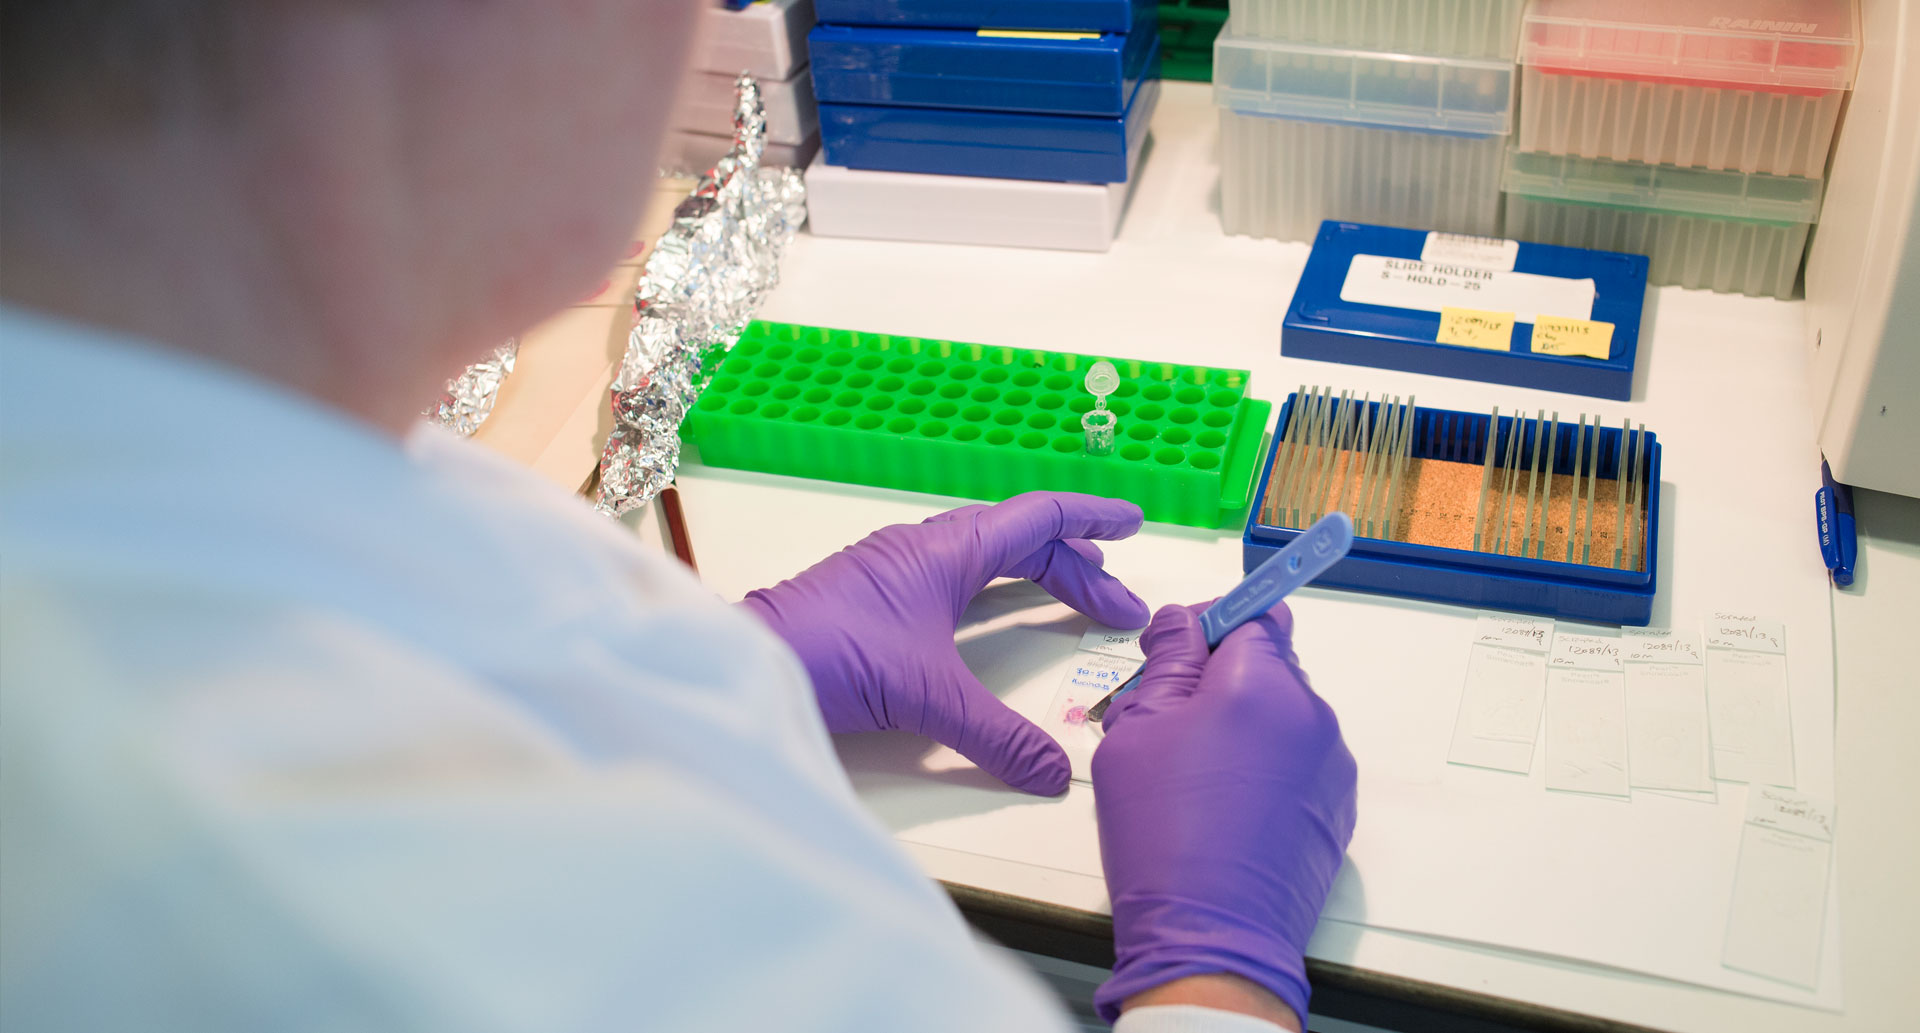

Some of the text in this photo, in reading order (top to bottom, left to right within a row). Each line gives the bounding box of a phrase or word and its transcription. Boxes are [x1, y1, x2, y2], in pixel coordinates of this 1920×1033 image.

[1707, 16, 1818, 33] RAININ
[1385, 260, 1494, 281] SLIDE HOLDER
[1821, 506, 1829, 533] BPS-GP
